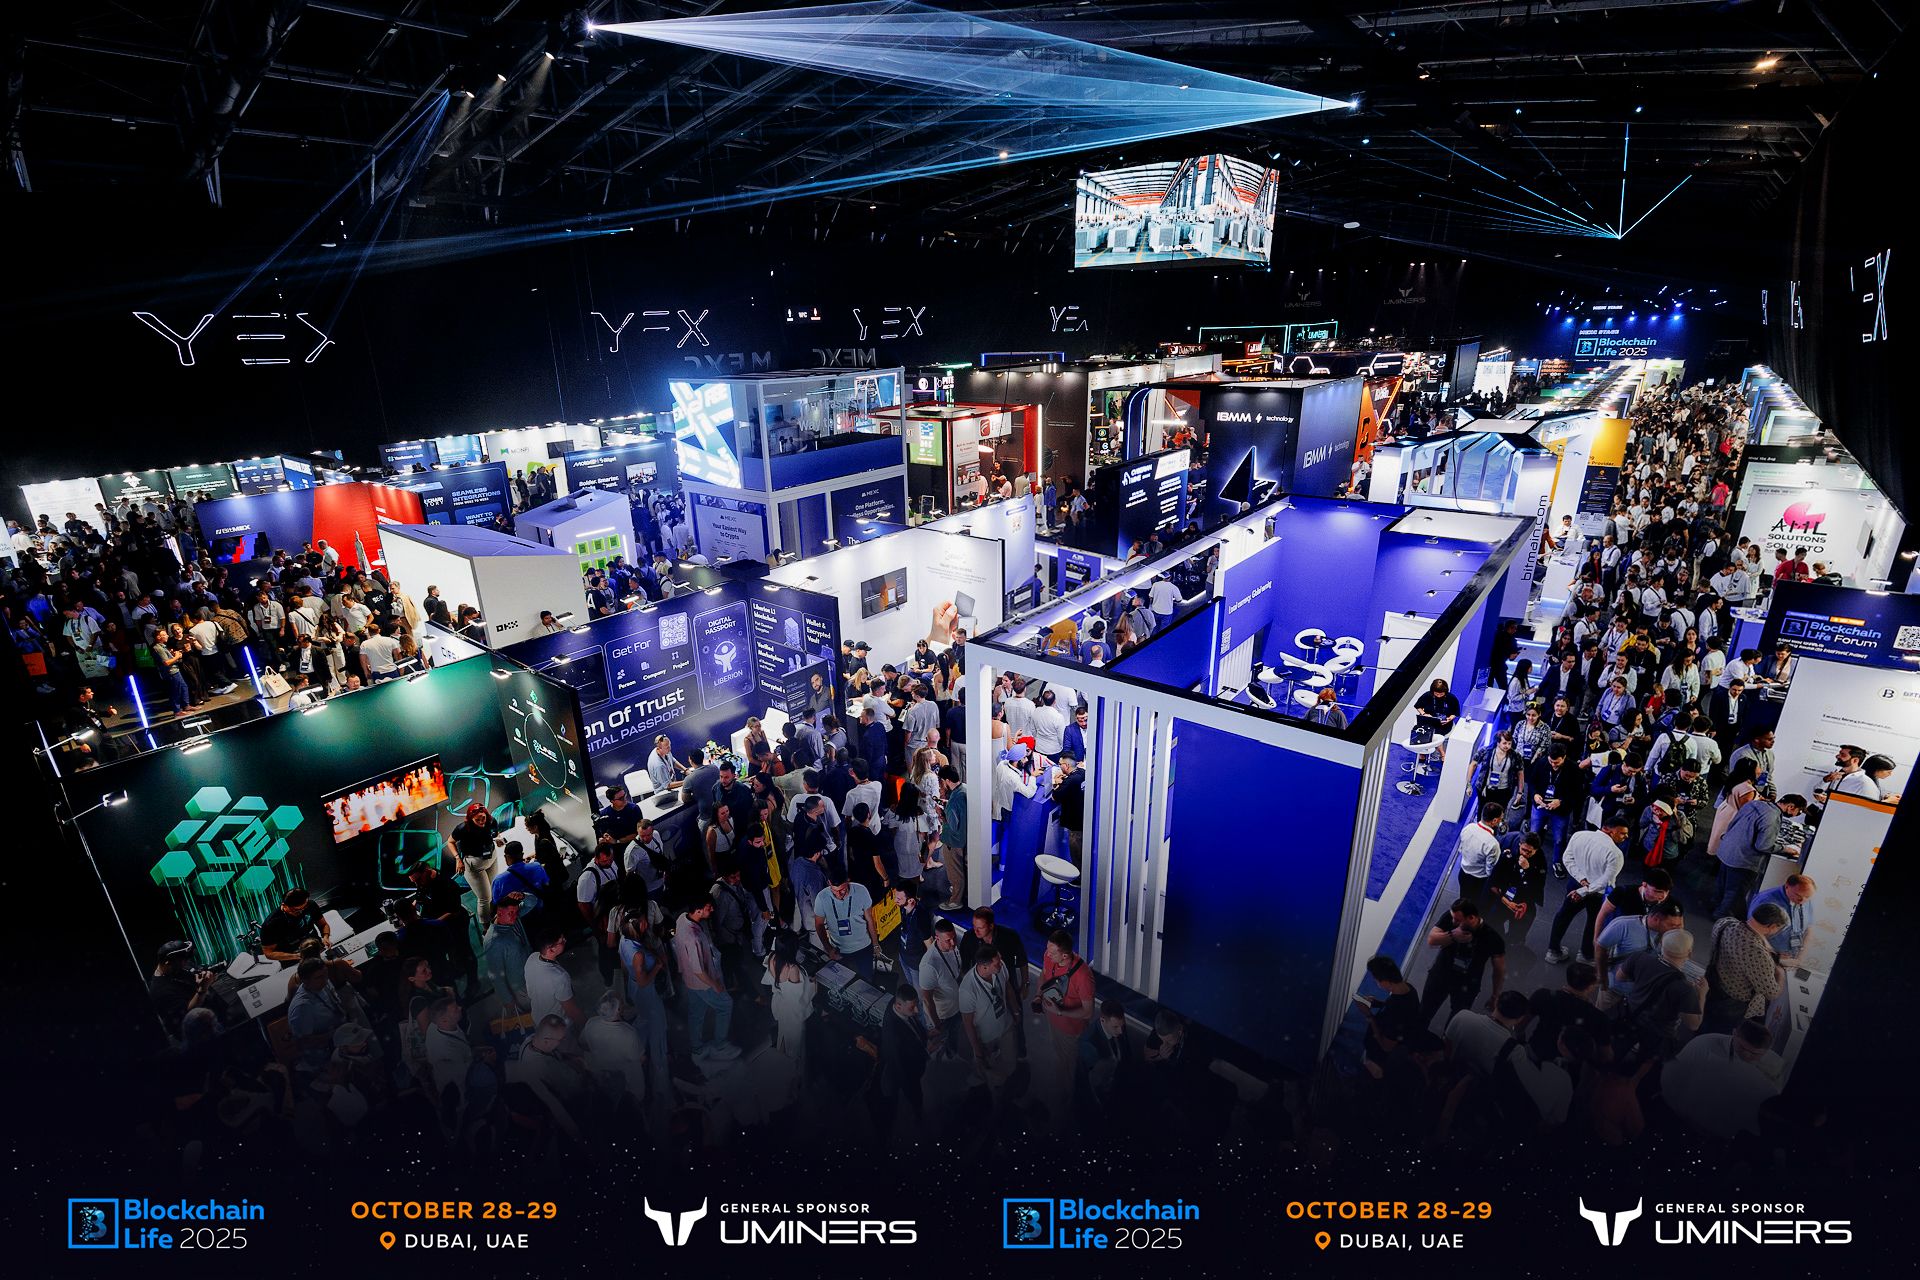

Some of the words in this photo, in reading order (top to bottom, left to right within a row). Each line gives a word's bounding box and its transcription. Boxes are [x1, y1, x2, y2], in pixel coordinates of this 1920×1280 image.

[1598, 337, 1657, 346] Blockchain
[1596, 347, 1618, 356] Life
[1618, 347, 1648, 356] 2025
[1216, 411, 1252, 423] IBMM
[1266, 415, 1294, 423] technology
[1303, 449, 1327, 469] IBMM
[451, 487, 487, 498] SEAMLESS
[452, 490, 501, 502] INTEGRATIONS
[864, 499, 885, 509] Platform.
[724, 532, 740, 540] Crypto
[1521, 495, 1549, 581] bitmain.com
[1767, 533, 1827, 544] SOLUTIONS
[752, 603, 771, 614] Liberion
[707, 615, 732, 628] DIGITAL
[753, 611, 777, 623] blockchain
[805, 618, 821, 628] Wallet
[704, 620, 736, 636] PASSPORT
[806, 627, 831, 639] Encrypted
[1809, 621, 1882, 639] Blockchain
[807, 635, 820, 644] Vault
[1806, 630, 1832, 641] Life
[1834, 634, 1878, 649] Forum
[612, 644, 632, 659] Get
[634, 639, 652, 652] For
[756, 641, 774, 652] Verified
[757, 649, 785, 664] Marketplace
[672, 660, 690, 670] Project
[642, 669, 667, 681] Company
[713, 669, 744, 687] LIBERION
[618, 680, 637, 690] Person
[608, 705, 632, 729] Of
[635, 687, 685, 717] Trust
[620, 705, 686, 740] PASSPORT
